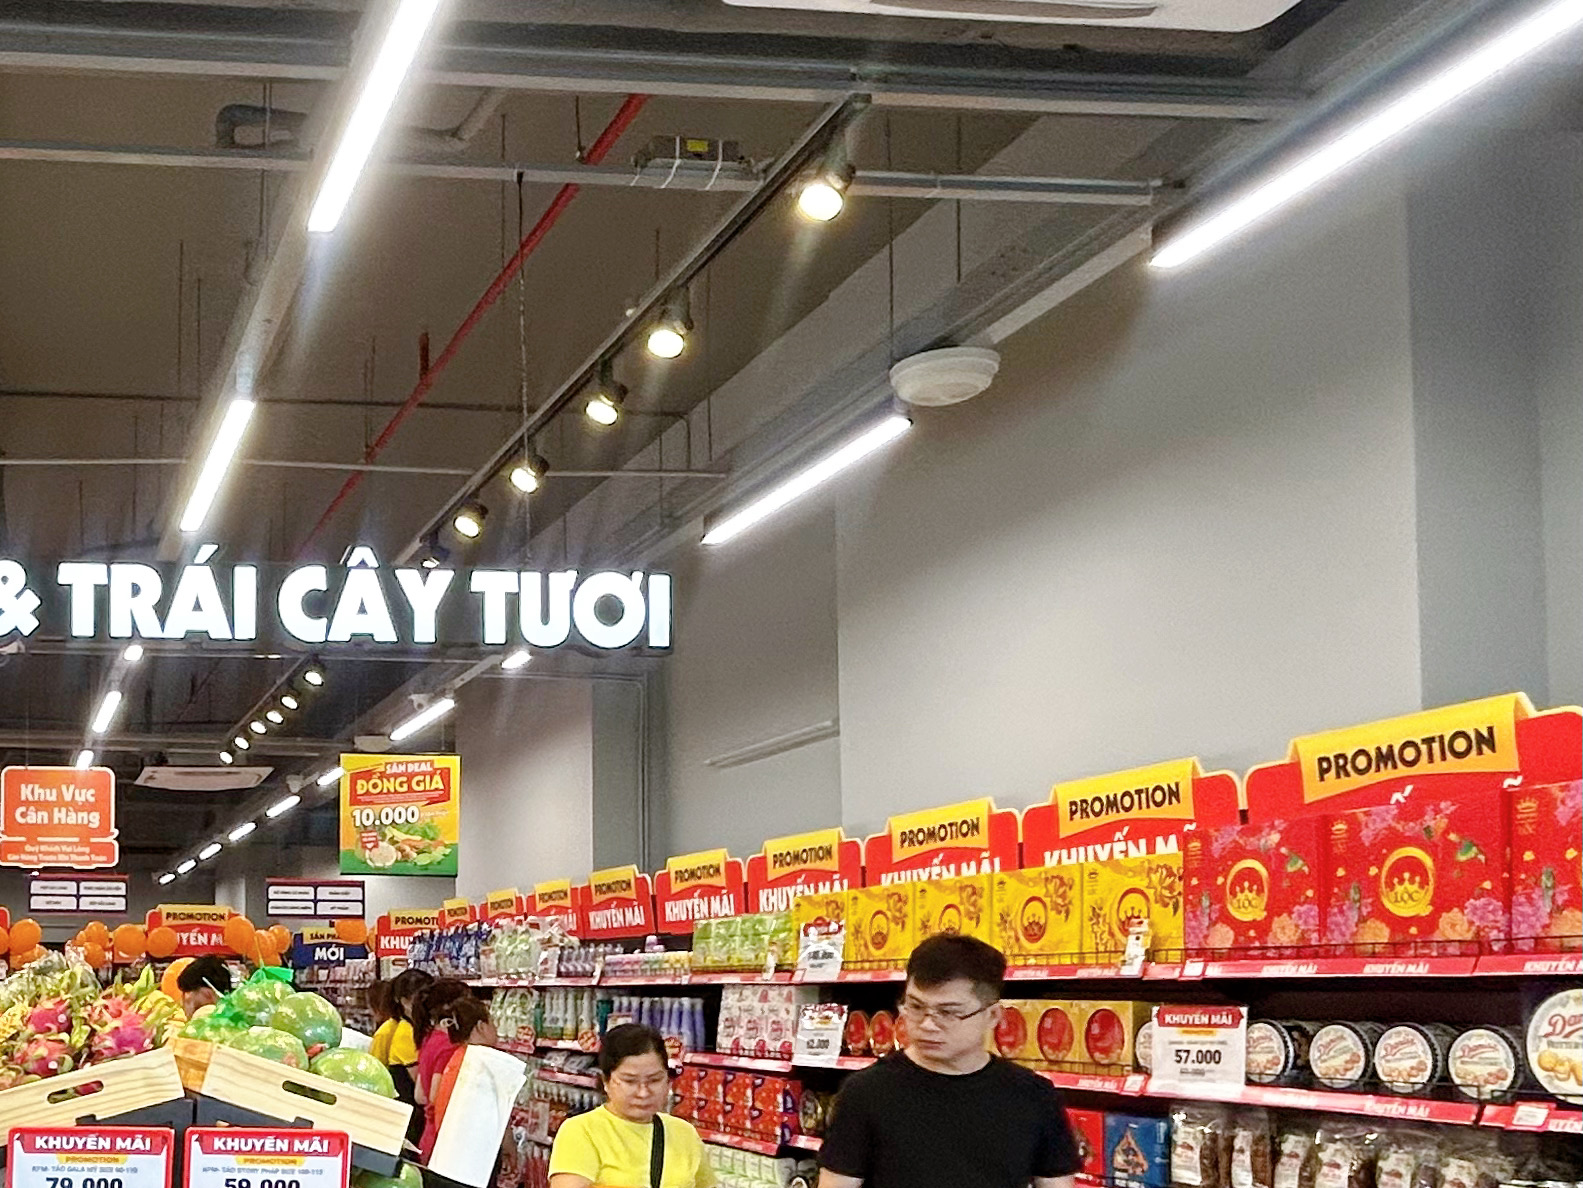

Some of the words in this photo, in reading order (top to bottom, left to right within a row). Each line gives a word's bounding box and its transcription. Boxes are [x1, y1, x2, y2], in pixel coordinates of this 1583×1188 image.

[57, 543, 257, 643] TRÁI
[277, 545, 443, 645] CÂY
[470, 568, 673, 651] TƯƠI
[1317, 725, 1497, 783] PROMOTION
[407, 761, 433, 773] DEAL
[356, 771, 408, 795] ĐỒNG
[411, 770, 445, 790] GIÁ
[20, 783, 58, 802] Khu
[61, 784, 96, 805] Vực
[1068, 782, 1181, 821] PROMOTION
[14, 806, 49, 824] Cân
[53, 806, 101, 829] Hàng
[352, 805, 420, 827] 10.000
[899, 817, 981, 849] PROMOTION
[772, 845, 833, 869] PROMOTION
[674, 863, 721, 884] PROMOTION
[166, 911, 226, 921] PROMOTION
[589, 900, 624, 930] KHUYẾN
[624, 904, 645, 928] MÃI
[665, 890, 709, 922] KHUYẾN
[709, 892, 734, 918] MÃI
[314, 945, 345, 961] MỚI
[1164, 1011, 1209, 1024] KHUYẾN
[1211, 1011, 1232, 1025] MÃI
[1175, 1049, 1222, 1064] 57.000
[35, 1132, 111, 1150] KHUYẾN
[116, 1134, 151, 1150] MÃI
[213, 1136, 288, 1152] KHUYẾN
[293, 1136, 329, 1153] MÃI
